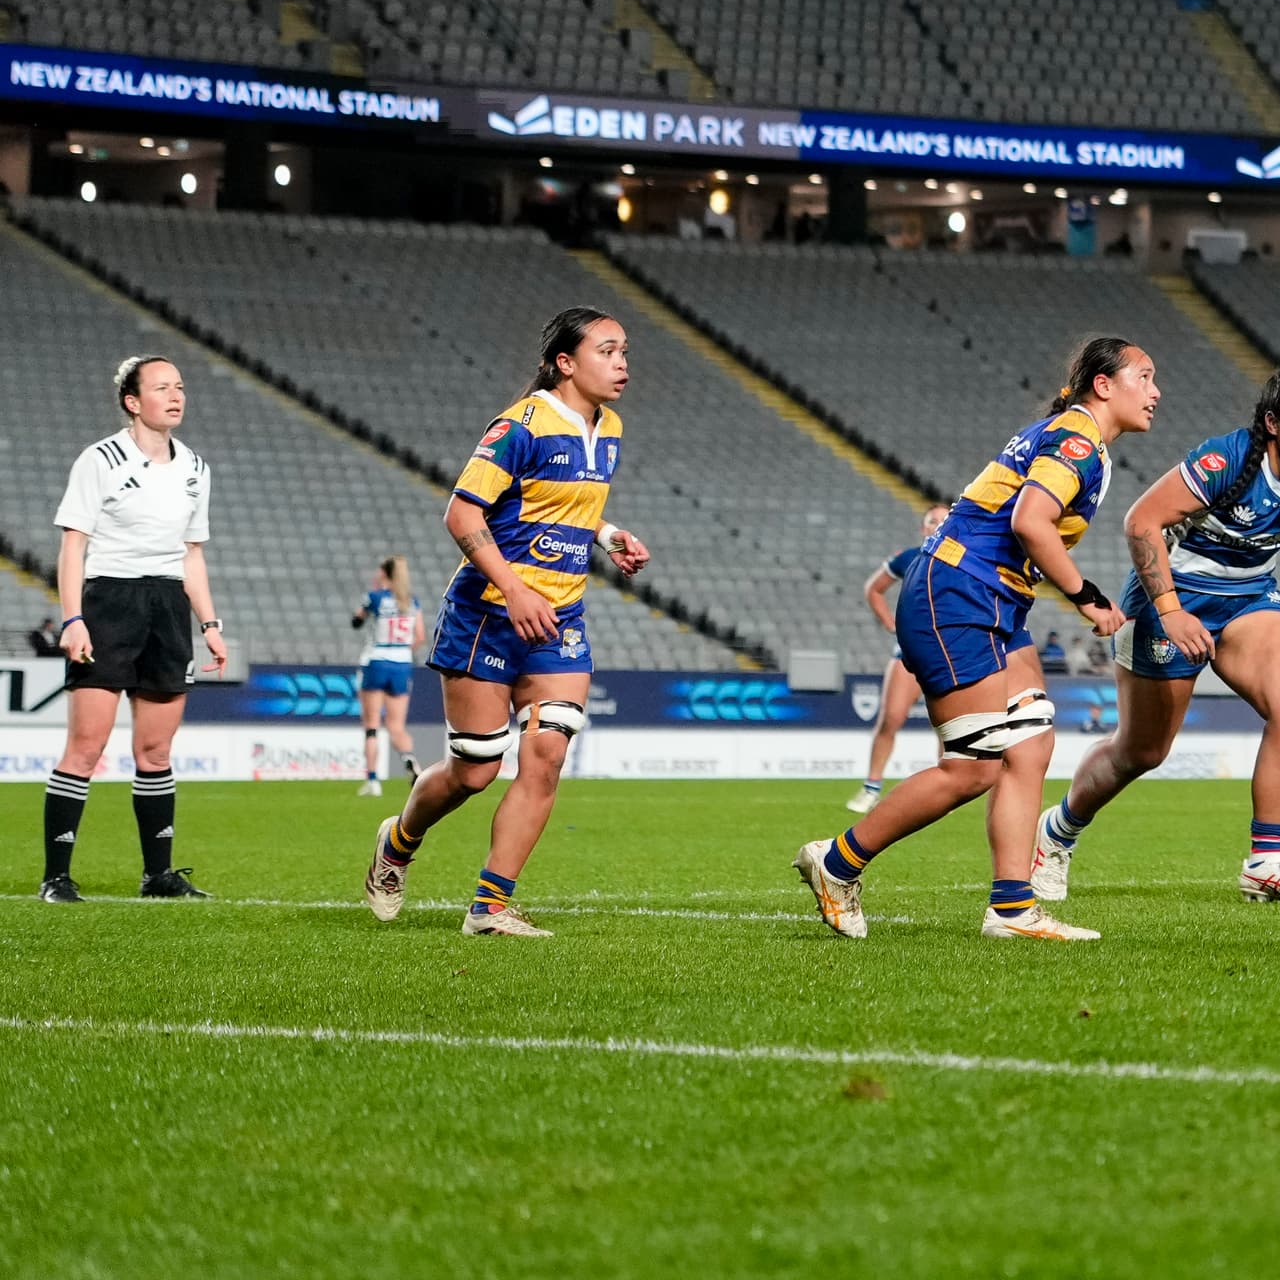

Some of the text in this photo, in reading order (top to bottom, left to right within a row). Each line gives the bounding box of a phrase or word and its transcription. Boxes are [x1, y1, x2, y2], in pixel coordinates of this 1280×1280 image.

[10, 61, 440, 122] NEW ZEALAND'S NATIONAL STADIUM
[552, 105, 744, 147] EDEN PARK
[758, 122, 1185, 169] NEW ZEALAND'S NATIONAL STADIUM
[252, 744, 364, 768] BUNNING
